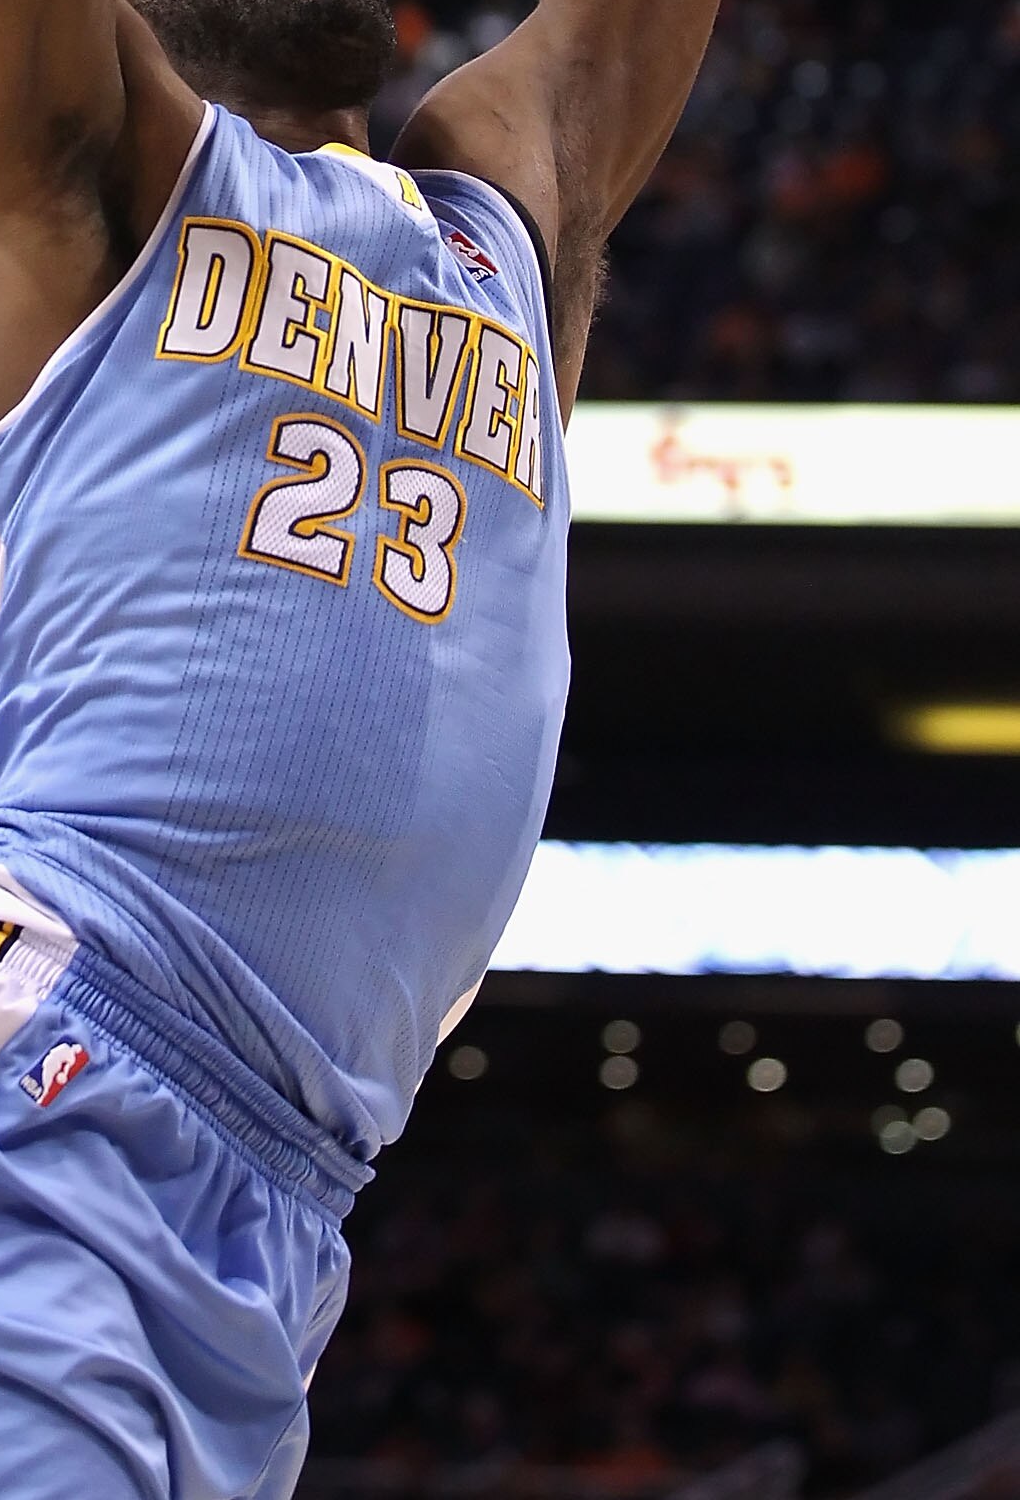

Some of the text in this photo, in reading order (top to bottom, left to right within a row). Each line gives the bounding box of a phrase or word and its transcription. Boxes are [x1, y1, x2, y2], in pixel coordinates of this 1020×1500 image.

[155, 217, 546, 512] DENVER
[471, 269, 489, 281] BA
[238, 412, 468, 625] 23
